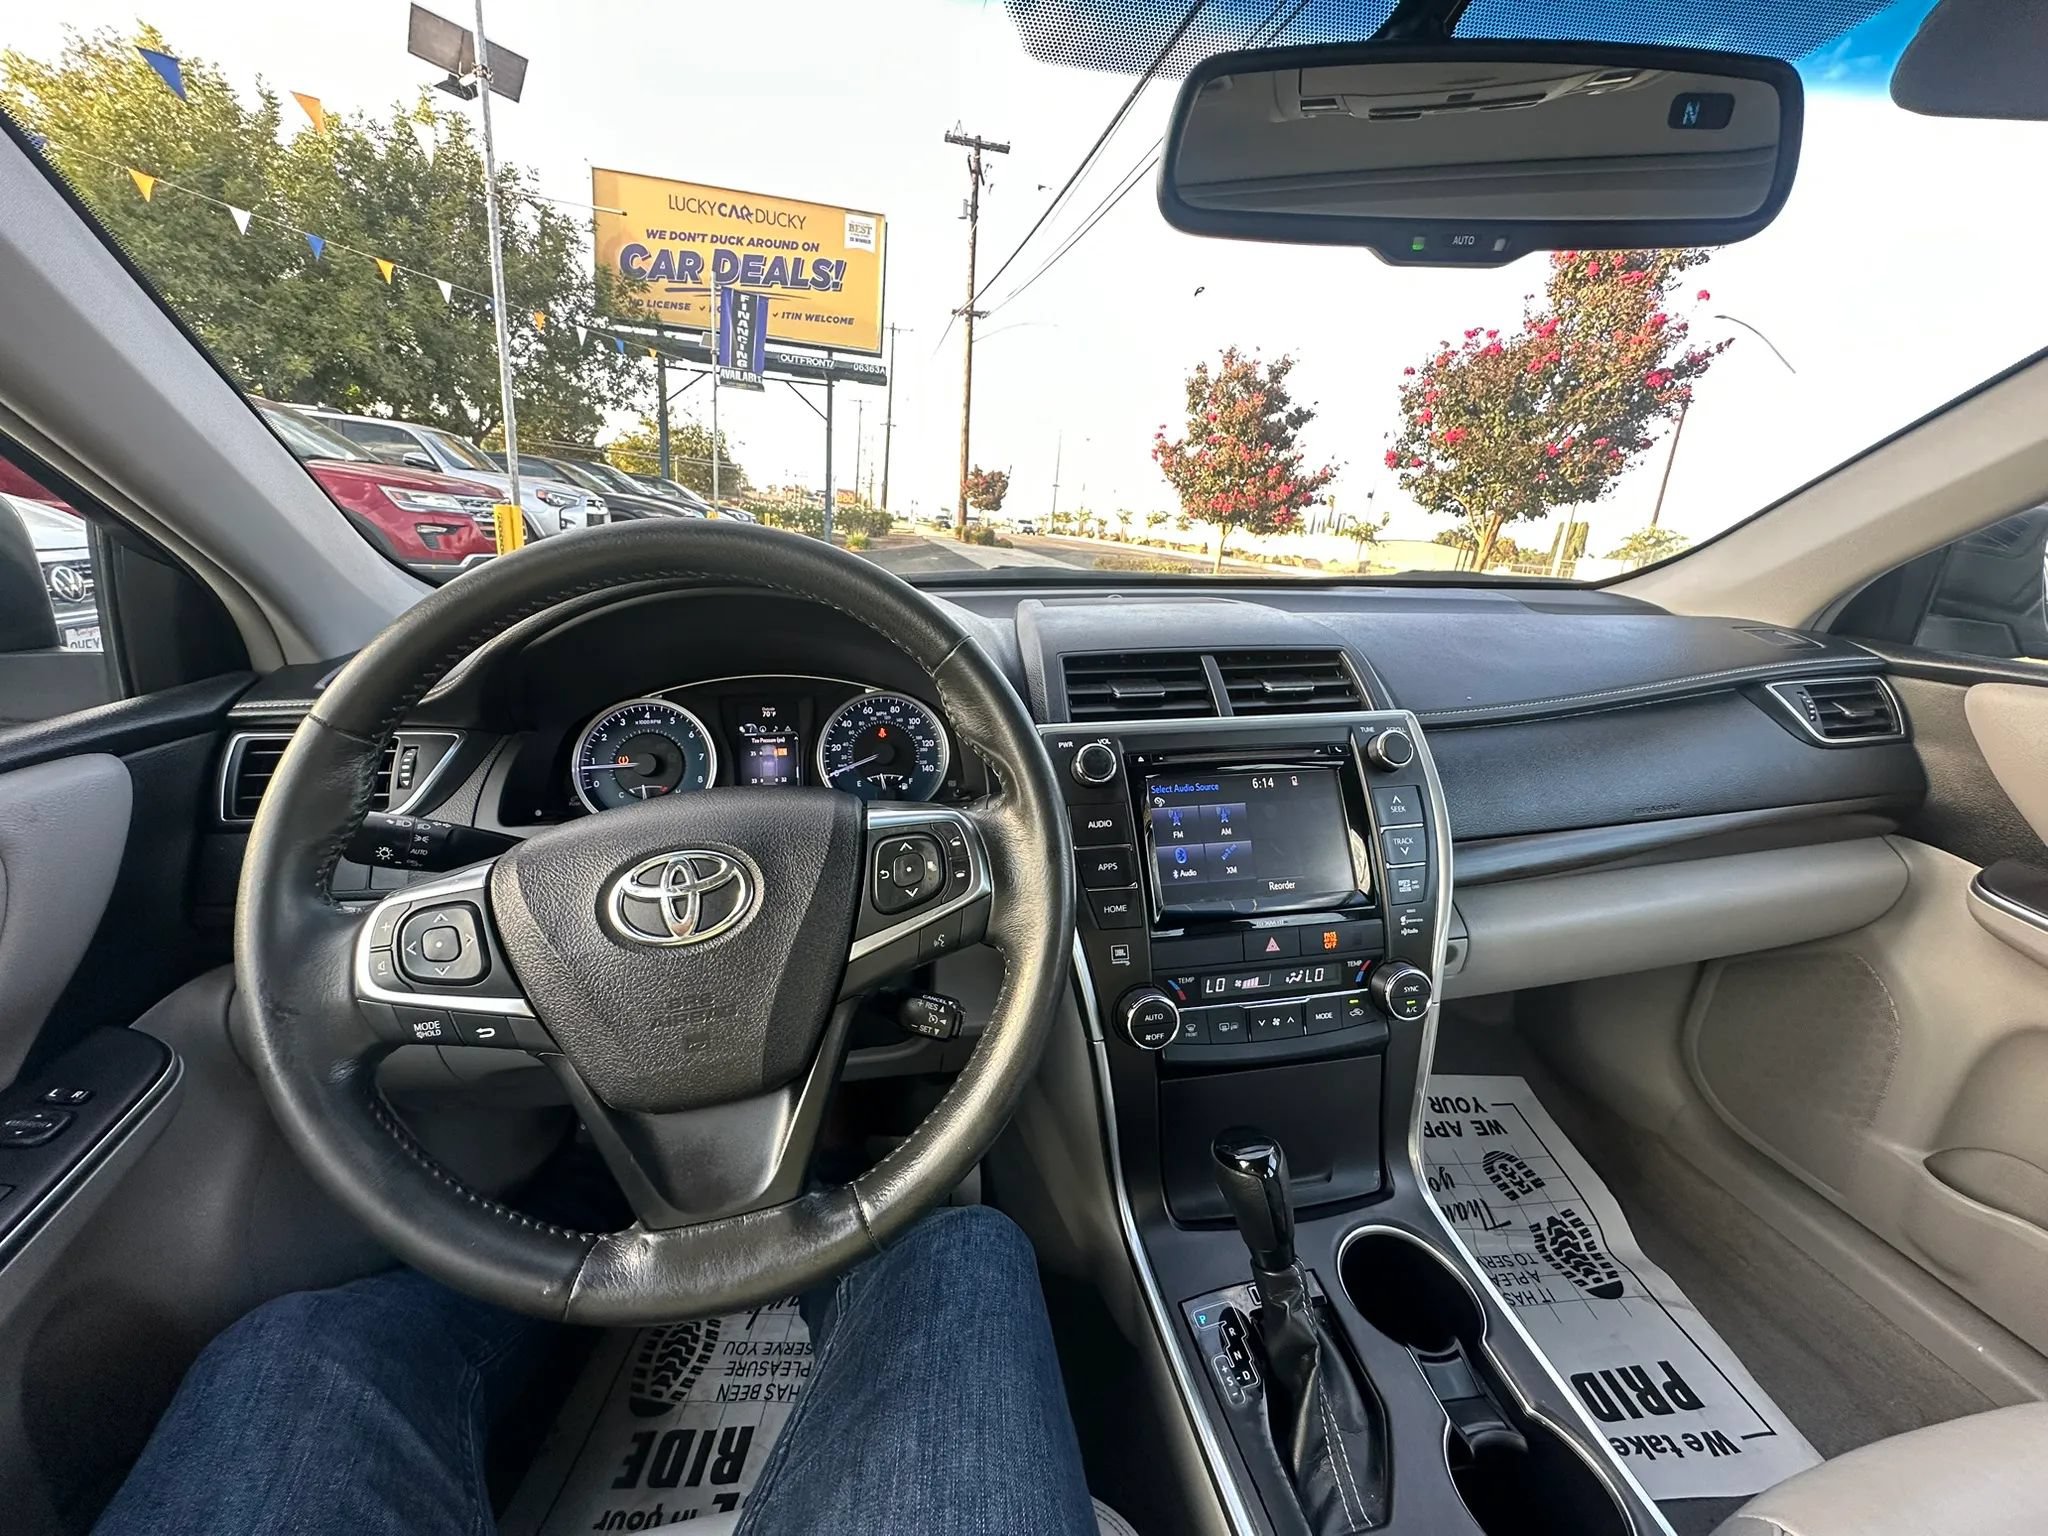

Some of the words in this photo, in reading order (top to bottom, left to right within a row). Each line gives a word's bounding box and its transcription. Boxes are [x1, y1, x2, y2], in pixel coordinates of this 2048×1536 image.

[849, 223, 873, 235] BEST
[646, 229, 667, 240] WE
[669, 230, 708, 243] DON'T
[710, 234, 747, 247] DUCK
[746, 237, 799, 251] AROUND
[801, 241, 820, 252] ON
[1452, 235, 1475, 245] AUTO
[619, 243, 704, 284] CAR
[712, 248, 848, 292] DEALS!
[646, 300, 692, 311] LICENSE
[781, 311, 803, 321] ITIN
[804, 313, 855, 325] WELCOME
[737, 294, 751, 368] FINANCING
[863, 706, 873, 714] 60
[841, 720, 852, 728] 40
[1150, 785, 1173, 794] Select
[1174, 783, 1195, 793] Audio
[1195, 781, 1219, 791] Source
[1252, 777, 1274, 789] 6:14
[1390, 805, 1406, 813] SEEK
[1088, 819, 1112, 829] AUDIO
[1173, 830, 1184, 839] FM
[1393, 837, 1413, 845] TRACK
[410, 848, 428, 856] AUTO
[1098, 862, 1118, 871] APPS
[1226, 866, 1238, 874] XM
[1180, 869, 1197, 878] Audio
[1269, 881, 1296, 890] Reorder
[1104, 904, 1127, 913] HOME
[1347, 960, 1362, 968] TEMP
[1178, 976, 1195, 984] TEMP
[1403, 985, 1419, 993] SYNC
[922, 994, 947, 1004] CANCEL
[925, 1002, 939, 1011] RES
[1144, 1013, 1163, 1021] AUTO
[1315, 1012, 1333, 1020] MODE
[413, 1020, 441, 1032] MODE
[919, 1024, 933, 1033] SET
[422, 1029, 442, 1037] HOLD
[1427, 1096, 1488, 1114] YOUR
[1470, 1120, 1508, 1136] WE
[1514, 1253, 1538, 1265] TO
[1502, 1290, 1538, 1307] HAS
[1538, 1287, 1556, 1303] IT
[1199, 1315, 1206, 1325] P
[1228, 1327, 1236, 1337] R
[723, 1341, 758, 1356] YOU
[762, 1341, 813, 1356] SERVE
[1233, 1350, 1242, 1361] N
[724, 1360, 812, 1377] PLEASURE
[1242, 1370, 1251, 1380] D
[1226, 1376, 1234, 1386] S
[716, 1383, 762, 1401] BEEN
[764, 1382, 801, 1401] HAS
[1608, 1434, 1684, 1461] take
[1681, 1430, 1742, 1457] We
